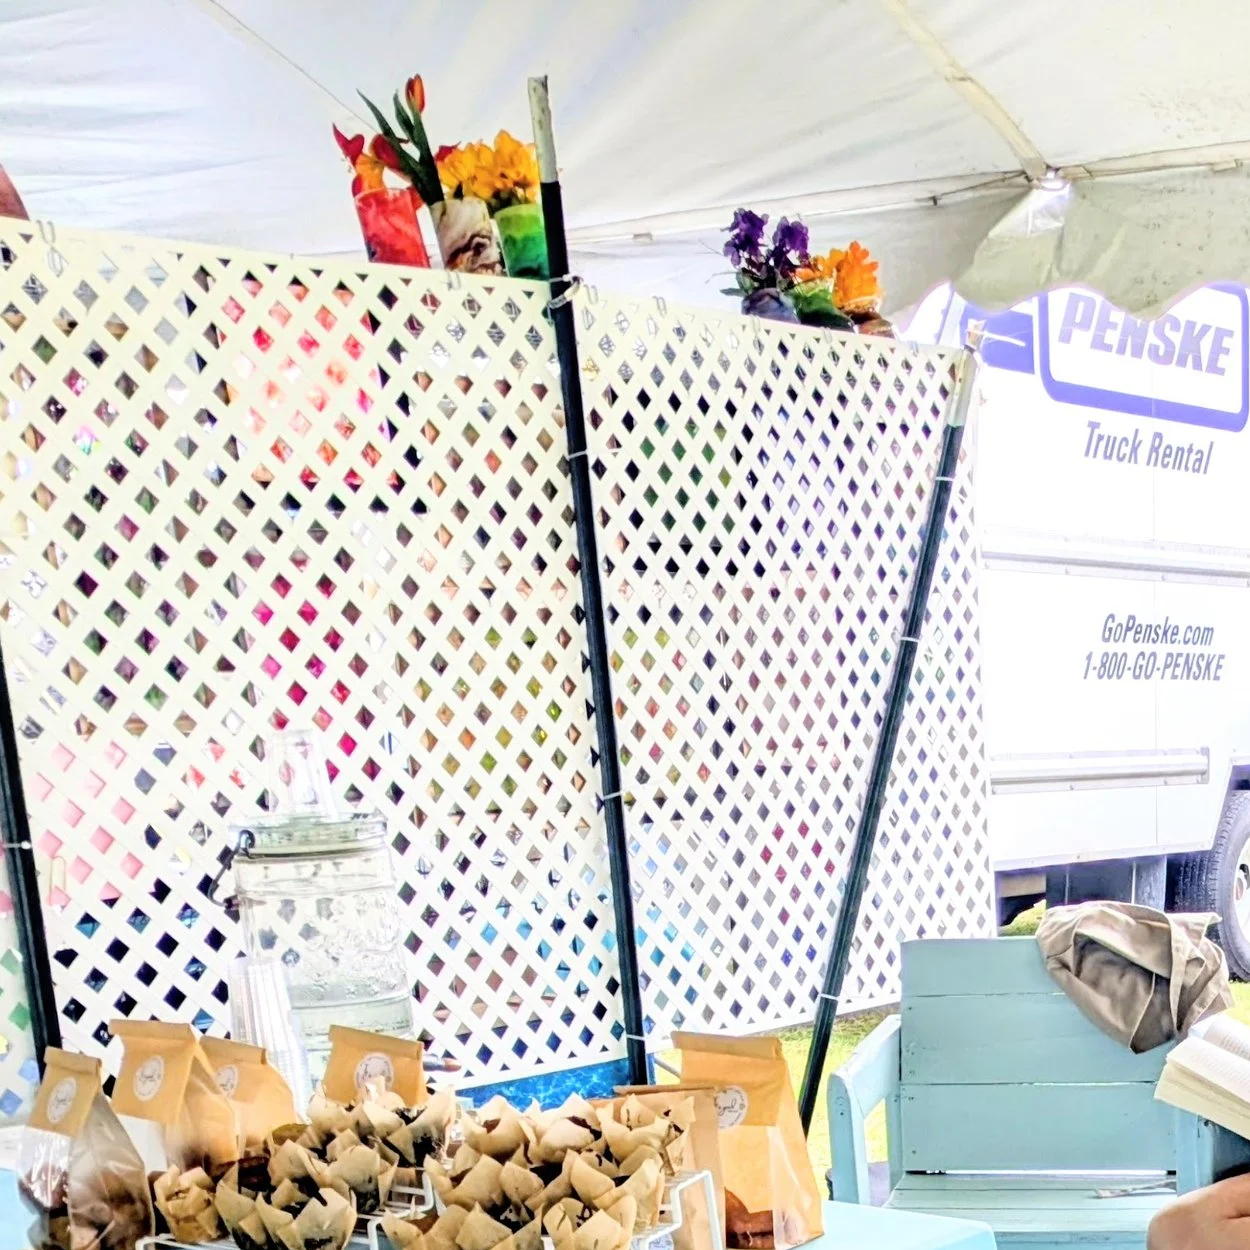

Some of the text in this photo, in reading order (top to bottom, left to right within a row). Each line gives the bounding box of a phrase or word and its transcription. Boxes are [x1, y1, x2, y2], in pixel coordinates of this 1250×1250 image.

[1058, 292, 1234, 376] PENSKE
[1084, 420, 1214, 475] Truck Rental
[1101, 613, 1214, 646] GoPenske.com
[1083, 651, 1226, 681] 1-800-GO-PENSKE
